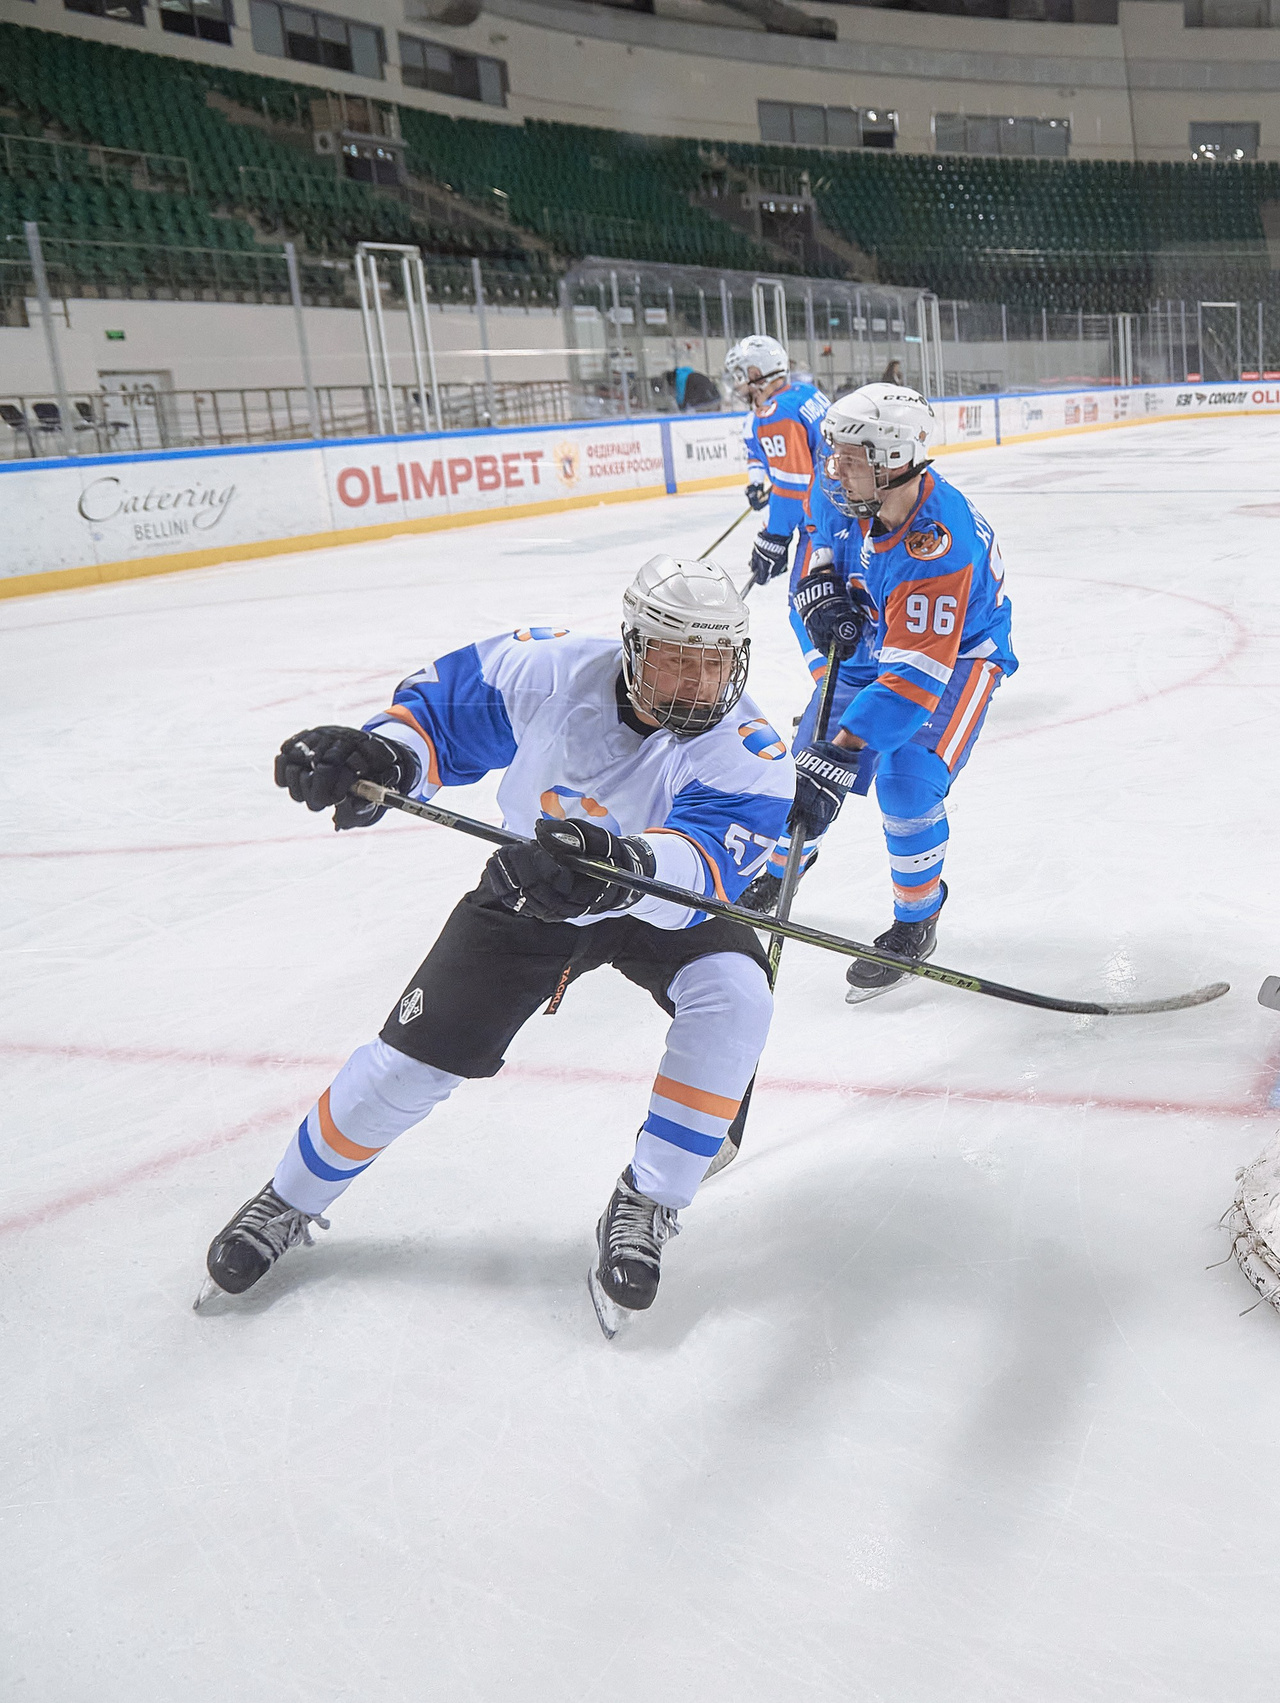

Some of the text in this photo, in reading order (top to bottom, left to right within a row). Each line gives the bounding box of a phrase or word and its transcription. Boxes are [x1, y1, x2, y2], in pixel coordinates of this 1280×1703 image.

[761, 434, 787, 458] 88
[337, 451, 544, 508] OLIMPBET
[78, 476, 237, 531] Catering
[133, 518, 190, 541] BELLINI
[691, 622, 730, 631] BAUER
[905, 593, 958, 636] 96
[402, 801, 458, 828] CCM
[724, 823, 778, 877] 57
[923, 967, 974, 988] CCM
